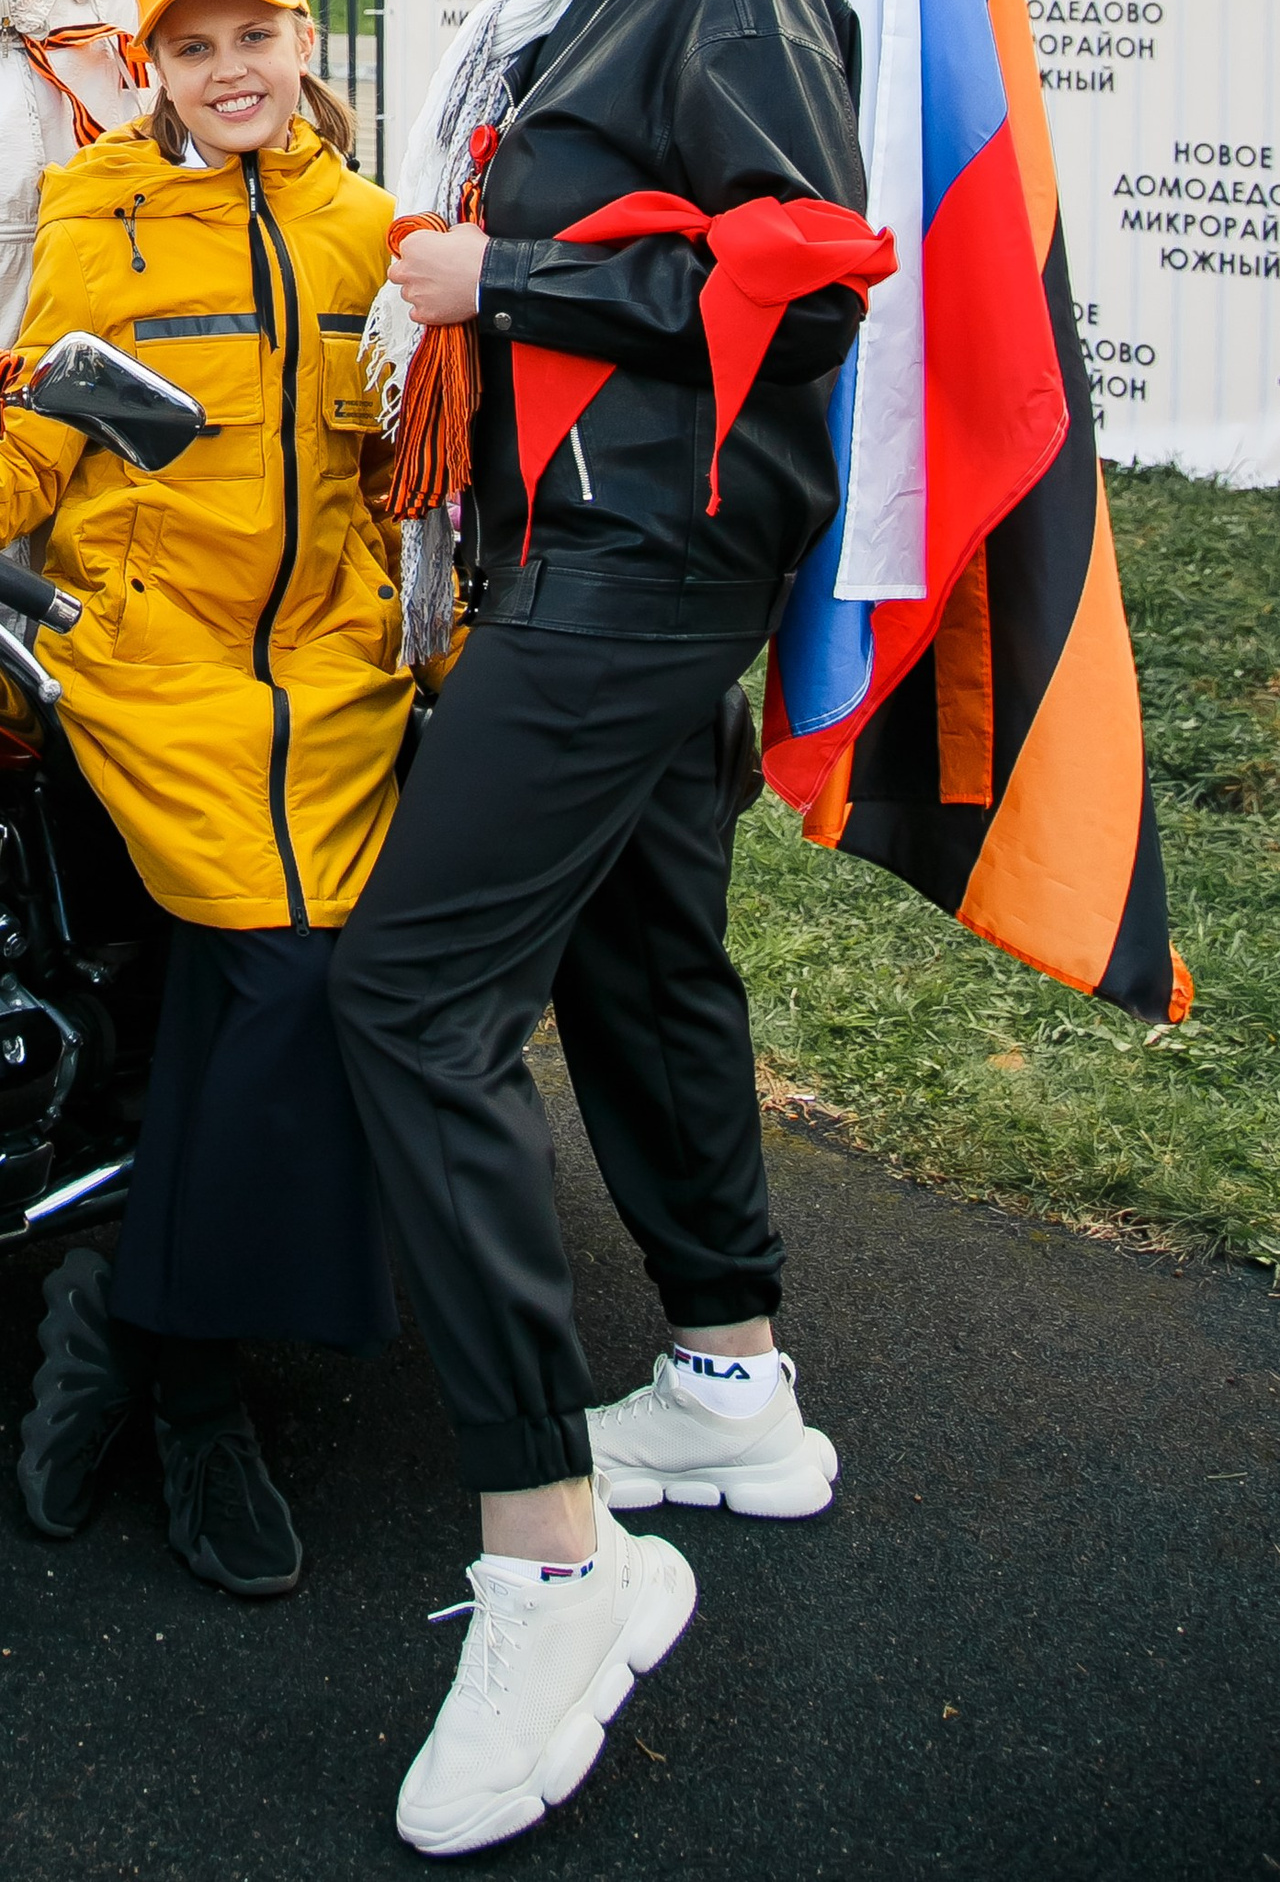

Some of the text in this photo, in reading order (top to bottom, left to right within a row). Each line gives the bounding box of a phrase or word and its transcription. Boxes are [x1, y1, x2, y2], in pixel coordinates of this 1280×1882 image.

[1027, 0, 1163, 24] ОДЕДОВО
[1038, 31, 1154, 58] ОРАЙОН
[1173, 140, 1273, 170] НОВОЕ
[1113, 173, 1280, 208] ДОМОДЕД
[1121, 208, 1279, 242] МИКРОРАЙ
[1161, 247, 1280, 279] ЮЖНЫЙ
[674, 1347, 752, 1380] FILA
